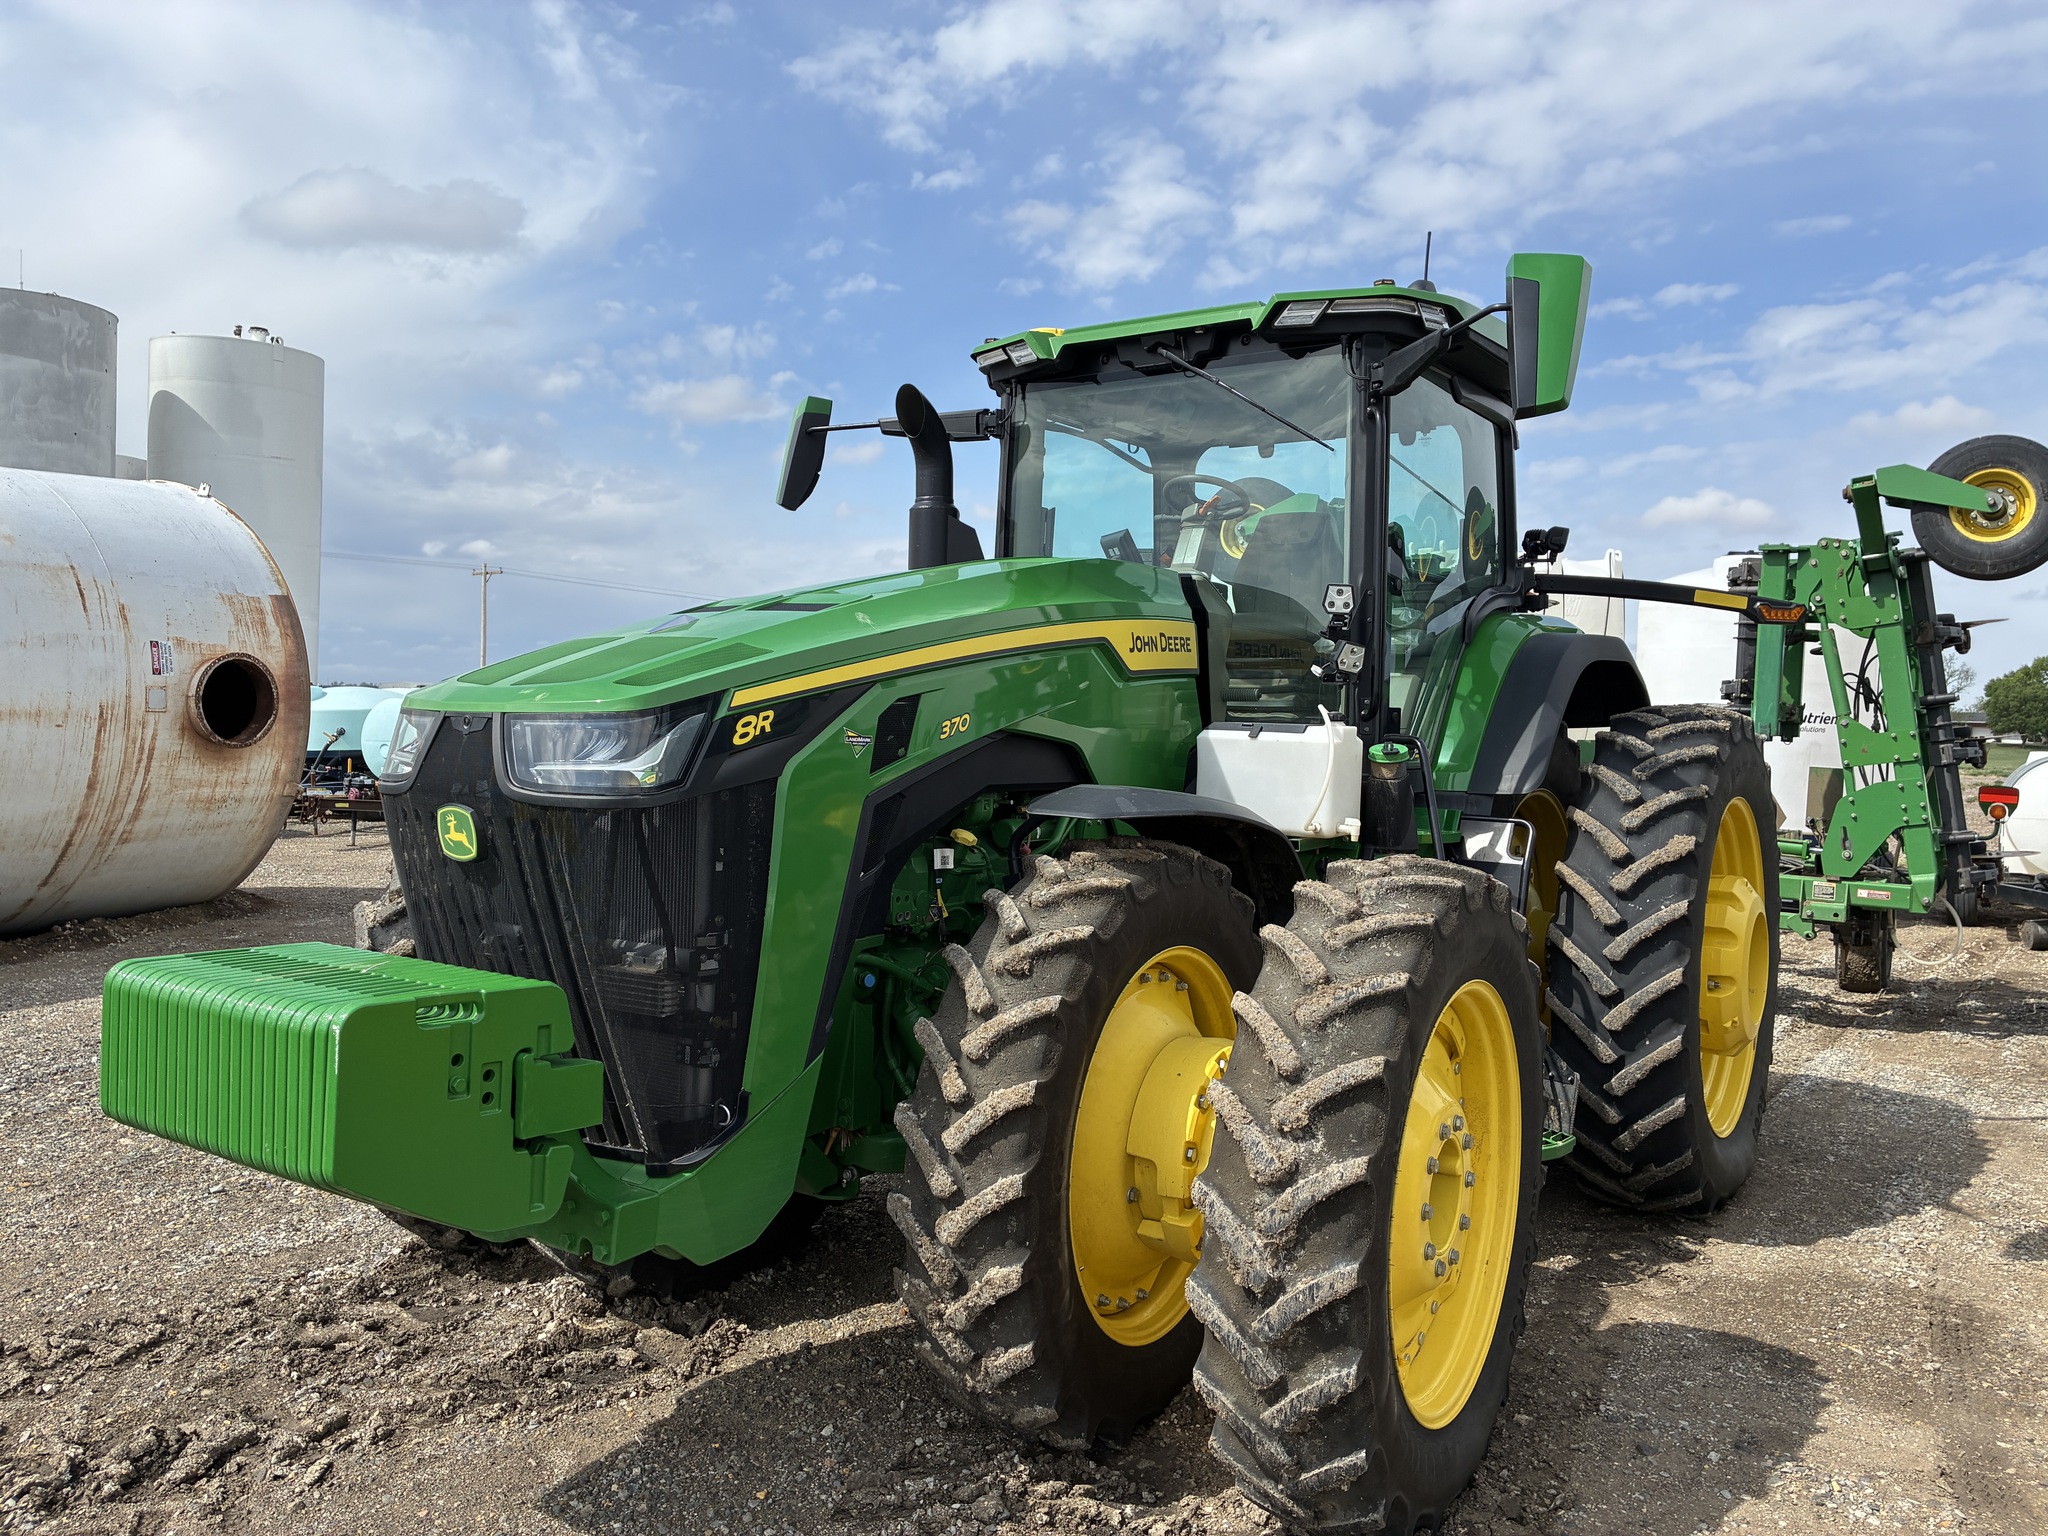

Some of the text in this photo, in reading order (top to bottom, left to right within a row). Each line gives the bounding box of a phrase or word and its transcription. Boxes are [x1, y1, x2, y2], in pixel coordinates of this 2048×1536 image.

[1129, 632, 1191, 653] JOHN DEERE
[733, 709, 775, 746] 8R
[939, 712, 971, 740] 370
